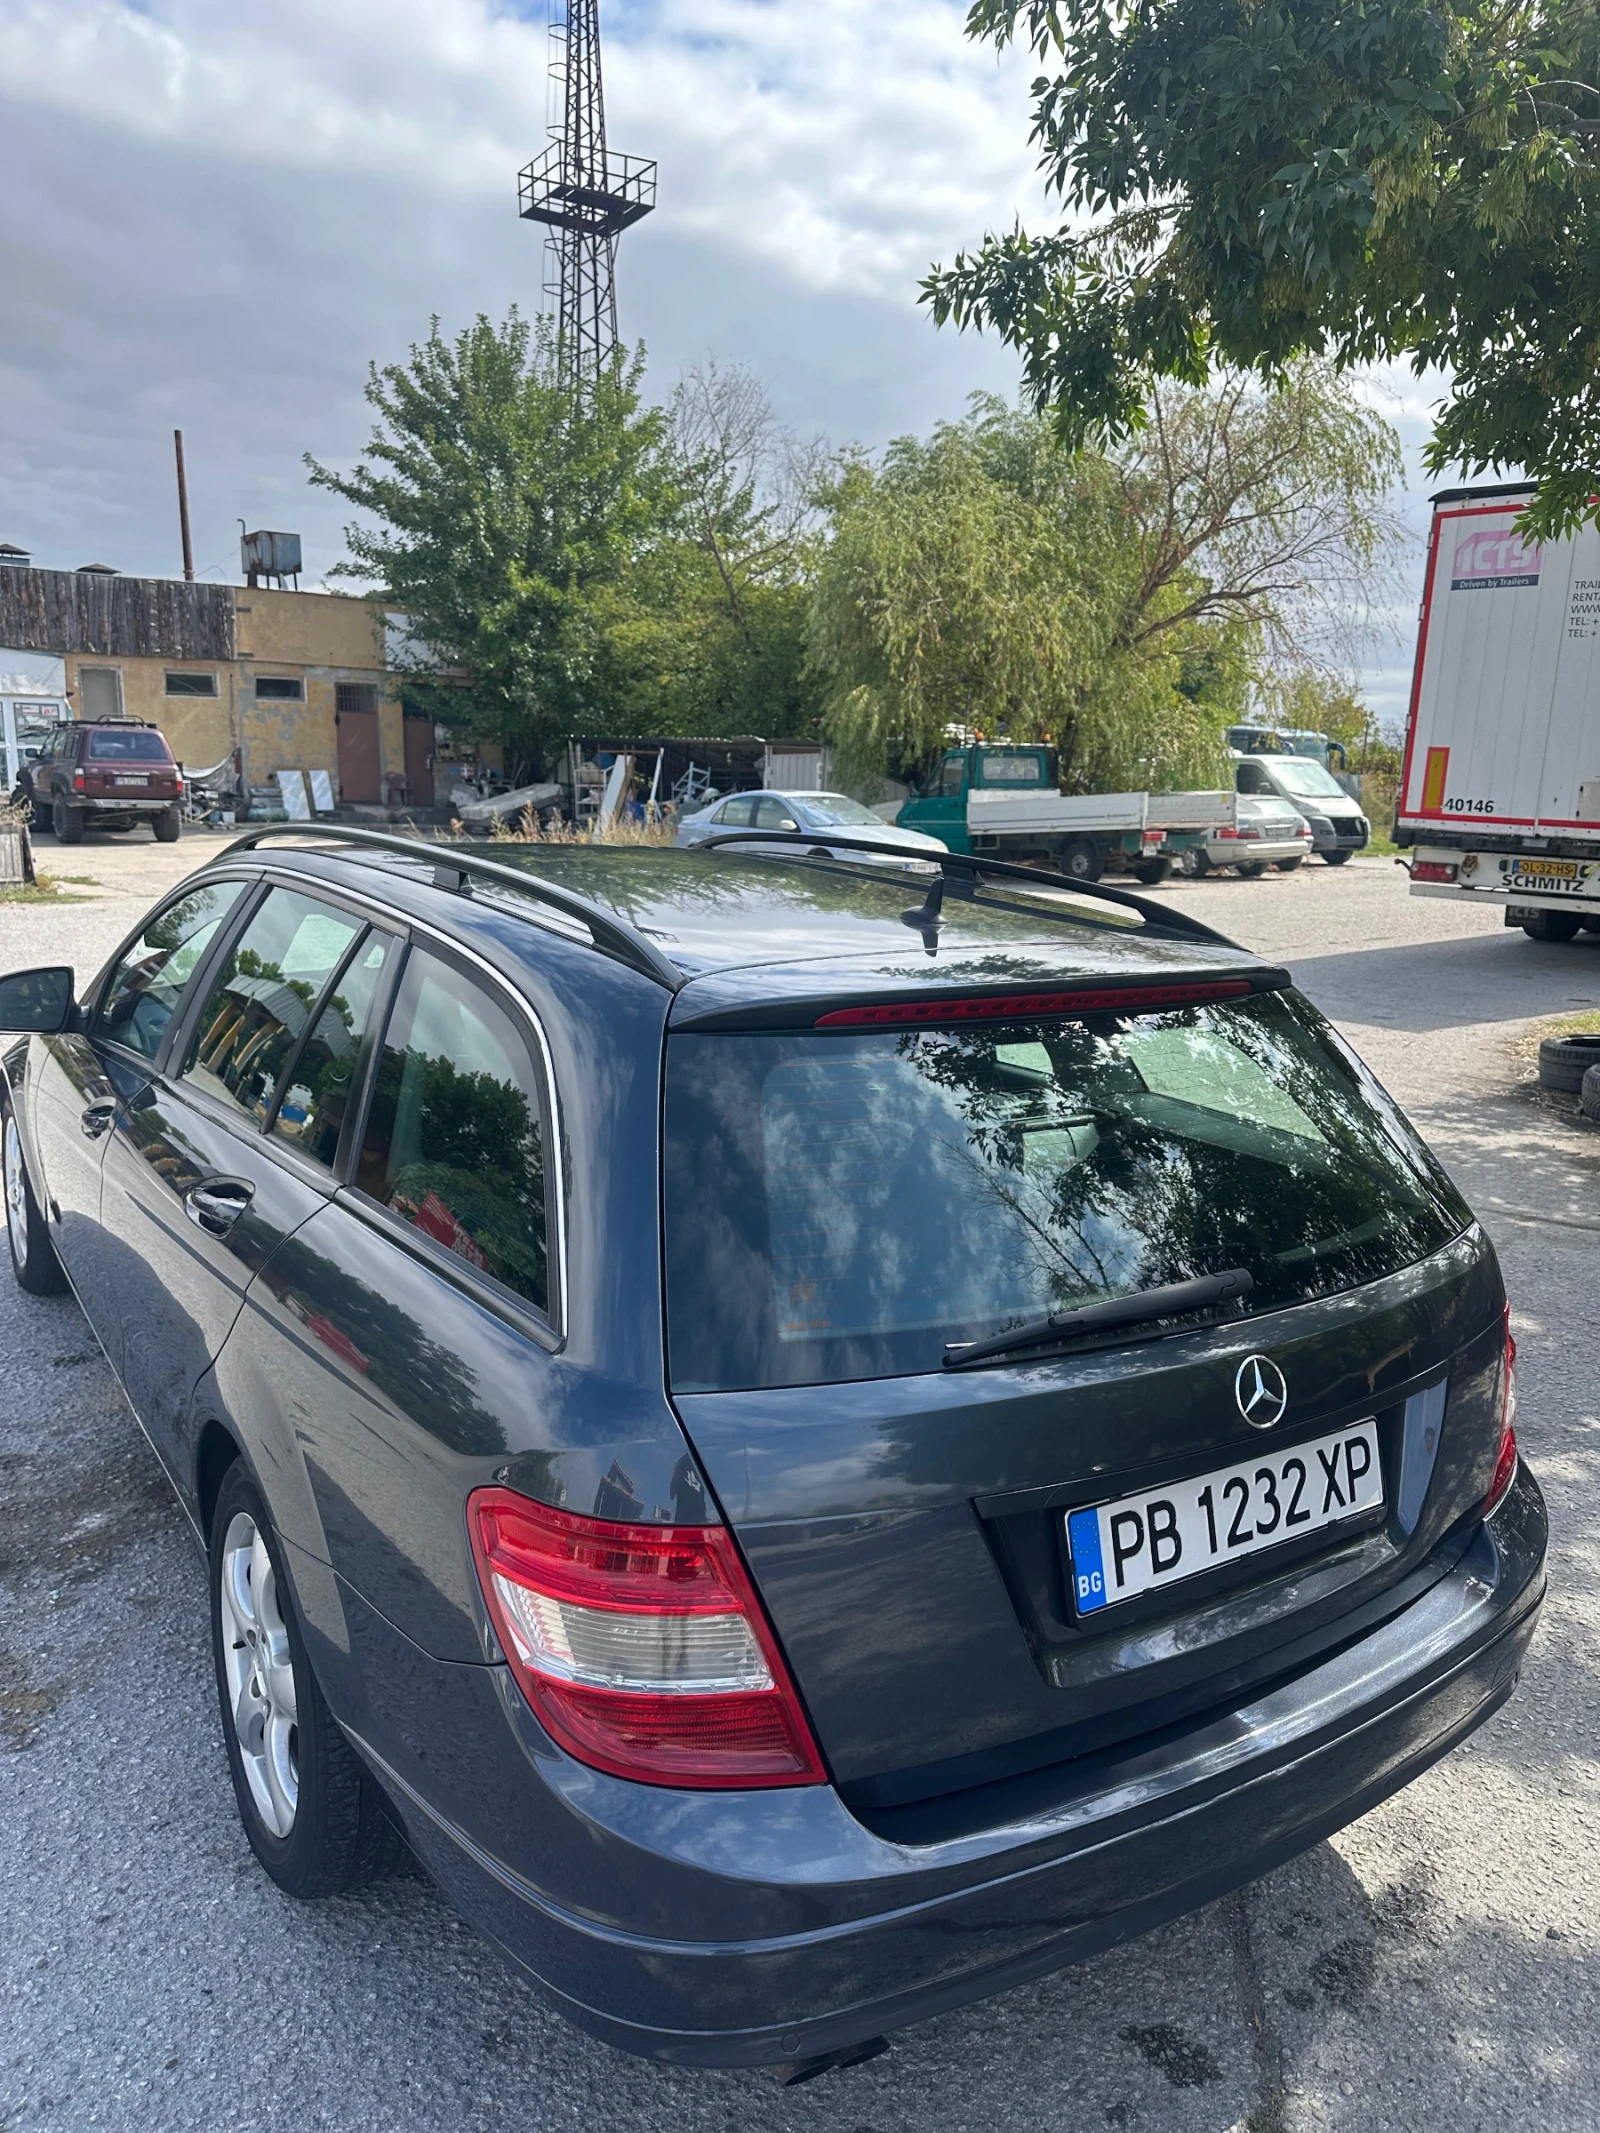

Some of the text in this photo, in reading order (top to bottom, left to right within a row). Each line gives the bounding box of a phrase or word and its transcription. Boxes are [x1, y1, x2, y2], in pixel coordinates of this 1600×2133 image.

[1488, 580, 1498, 588] by
[1500, 578, 1529, 586] Trailers
[1570, 617, 1590, 626] TEL:
[1568, 629, 1588, 638] TEL:
[1445, 798, 1494, 813] 40146
[1502, 874, 1584, 892] SCHMITZ
[1110, 1435, 1371, 1588] PB 1232 XP
[1078, 1572, 1102, 1598] BG
